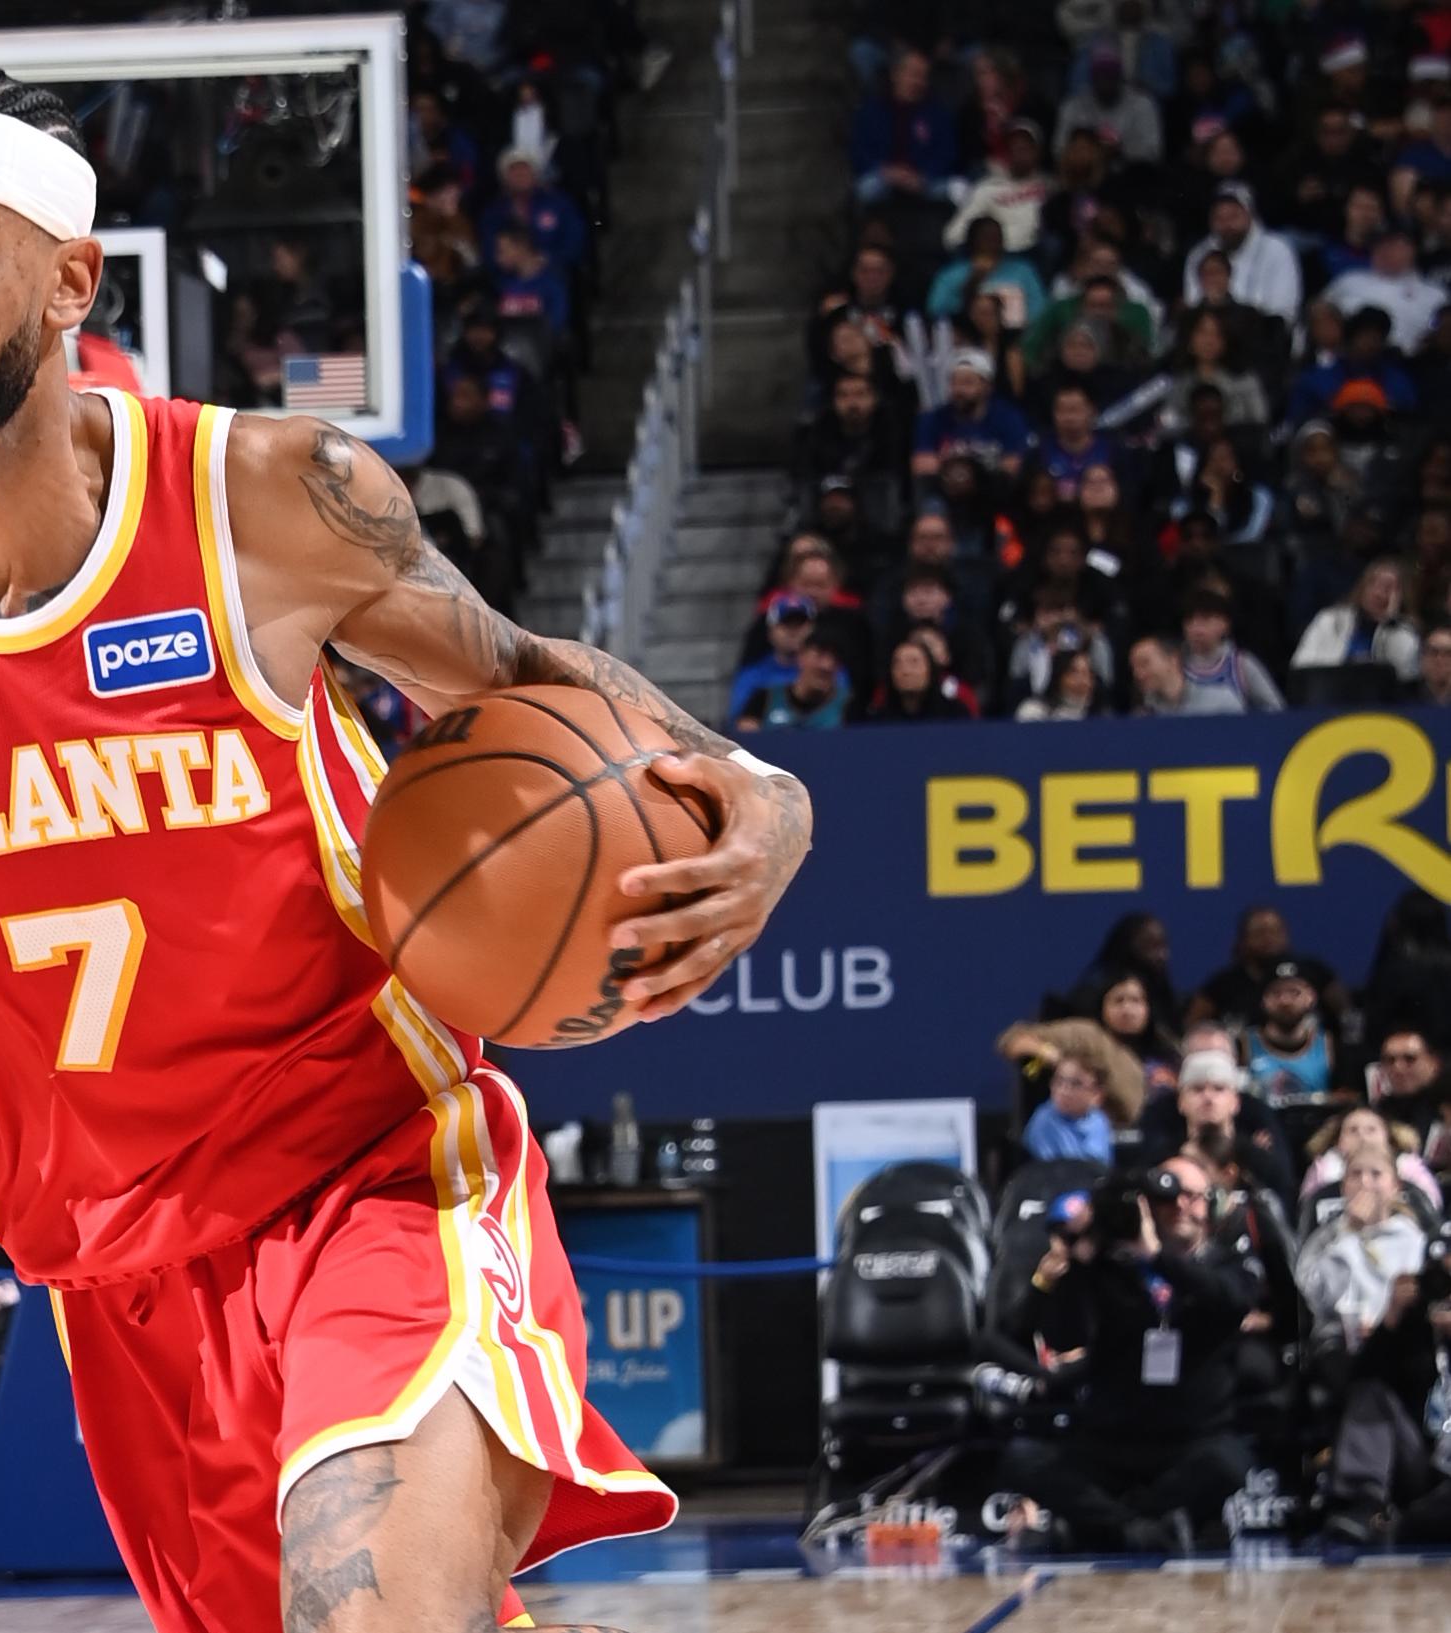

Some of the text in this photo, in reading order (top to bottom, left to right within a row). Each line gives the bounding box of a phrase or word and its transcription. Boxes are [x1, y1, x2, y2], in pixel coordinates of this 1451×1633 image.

[97, 631, 198, 679] paze
[925, 712, 1451, 905] BETR
[606, 1288, 686, 1350] UP
